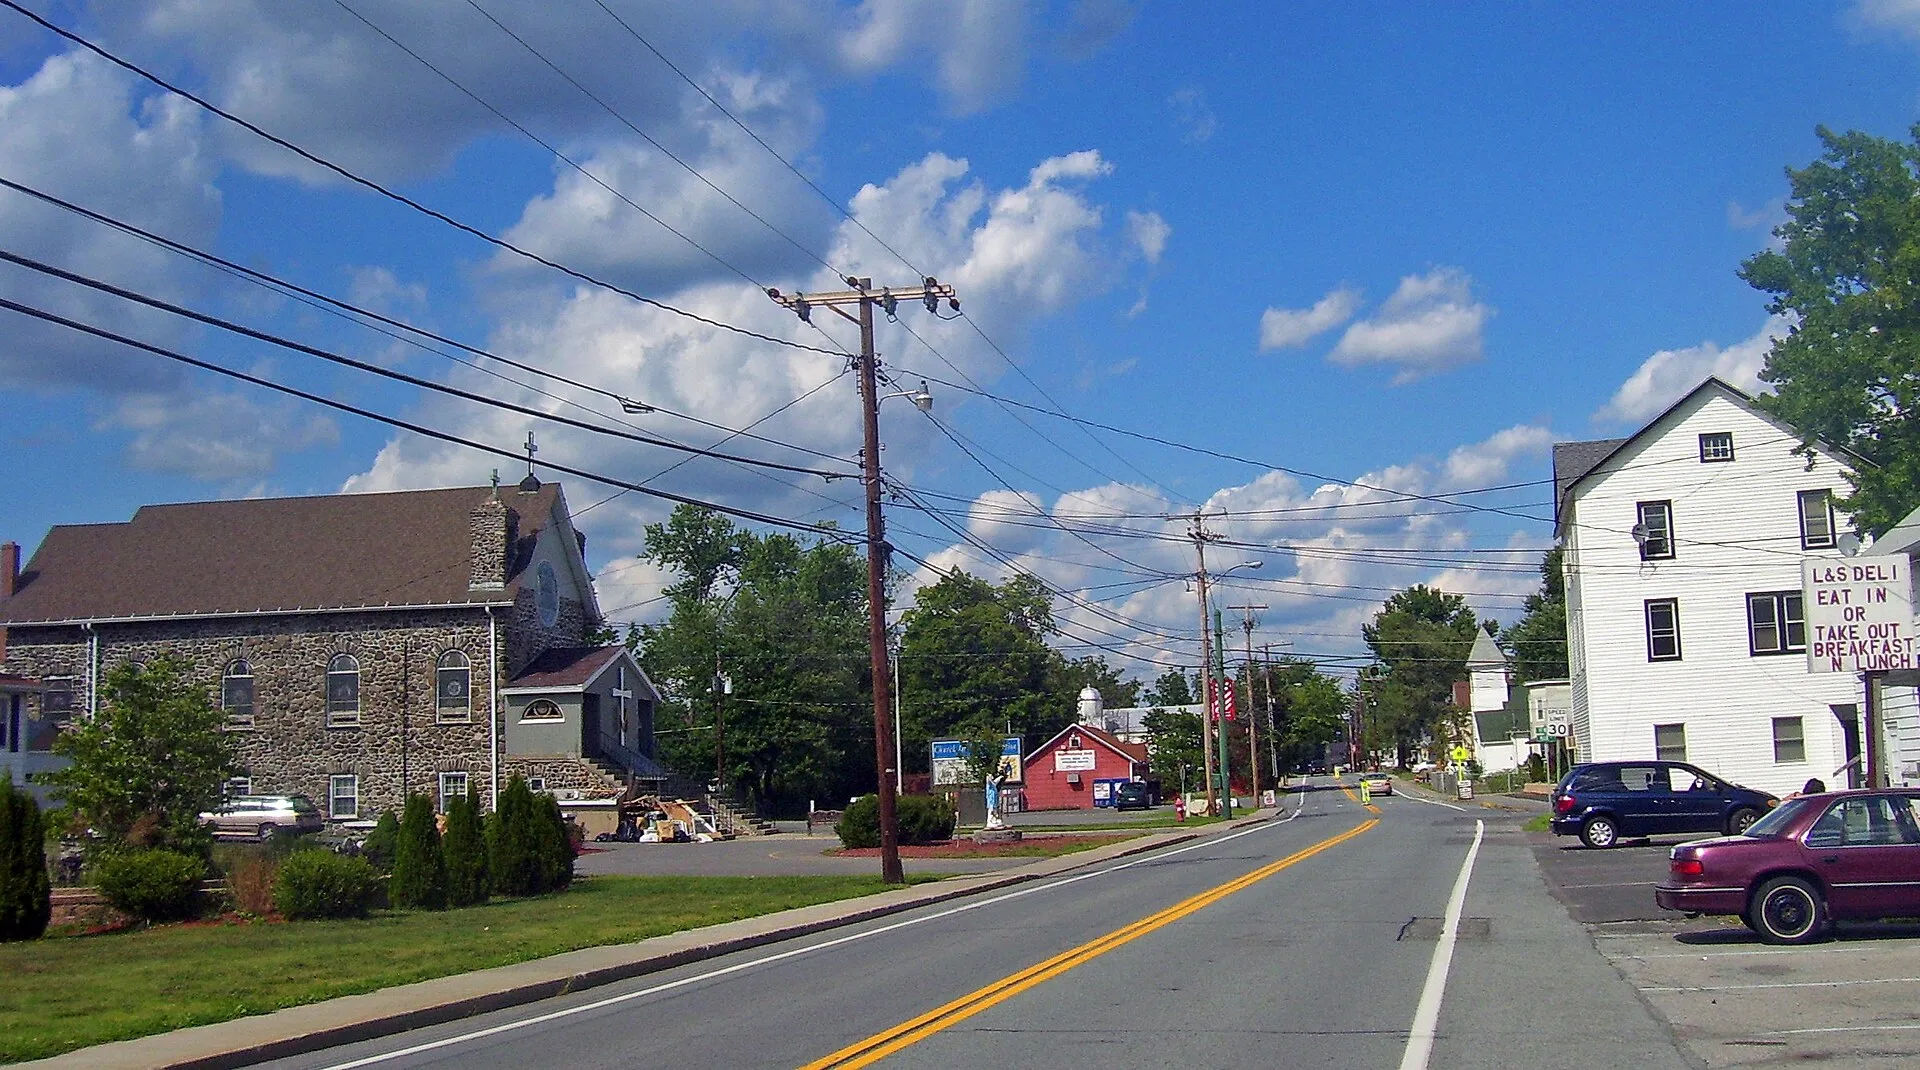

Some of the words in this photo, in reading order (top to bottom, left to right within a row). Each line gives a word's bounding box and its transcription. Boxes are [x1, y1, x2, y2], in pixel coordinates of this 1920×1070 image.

[1813, 567, 1847, 583] L&S
[1853, 565, 1897, 581] DELI
[1818, 589, 1851, 605] EAT
[1867, 588, 1887, 603] IN
[1844, 606, 1866, 621] OR
[1815, 625, 1859, 640] TAKE
[1868, 623, 1899, 638] OUT
[1814, 638, 1914, 657] BREAKFAST
[1832, 657, 1842, 672] N
[1856, 654, 1911, 671] LUNCH
[1548, 724, 1567, 735] 30
